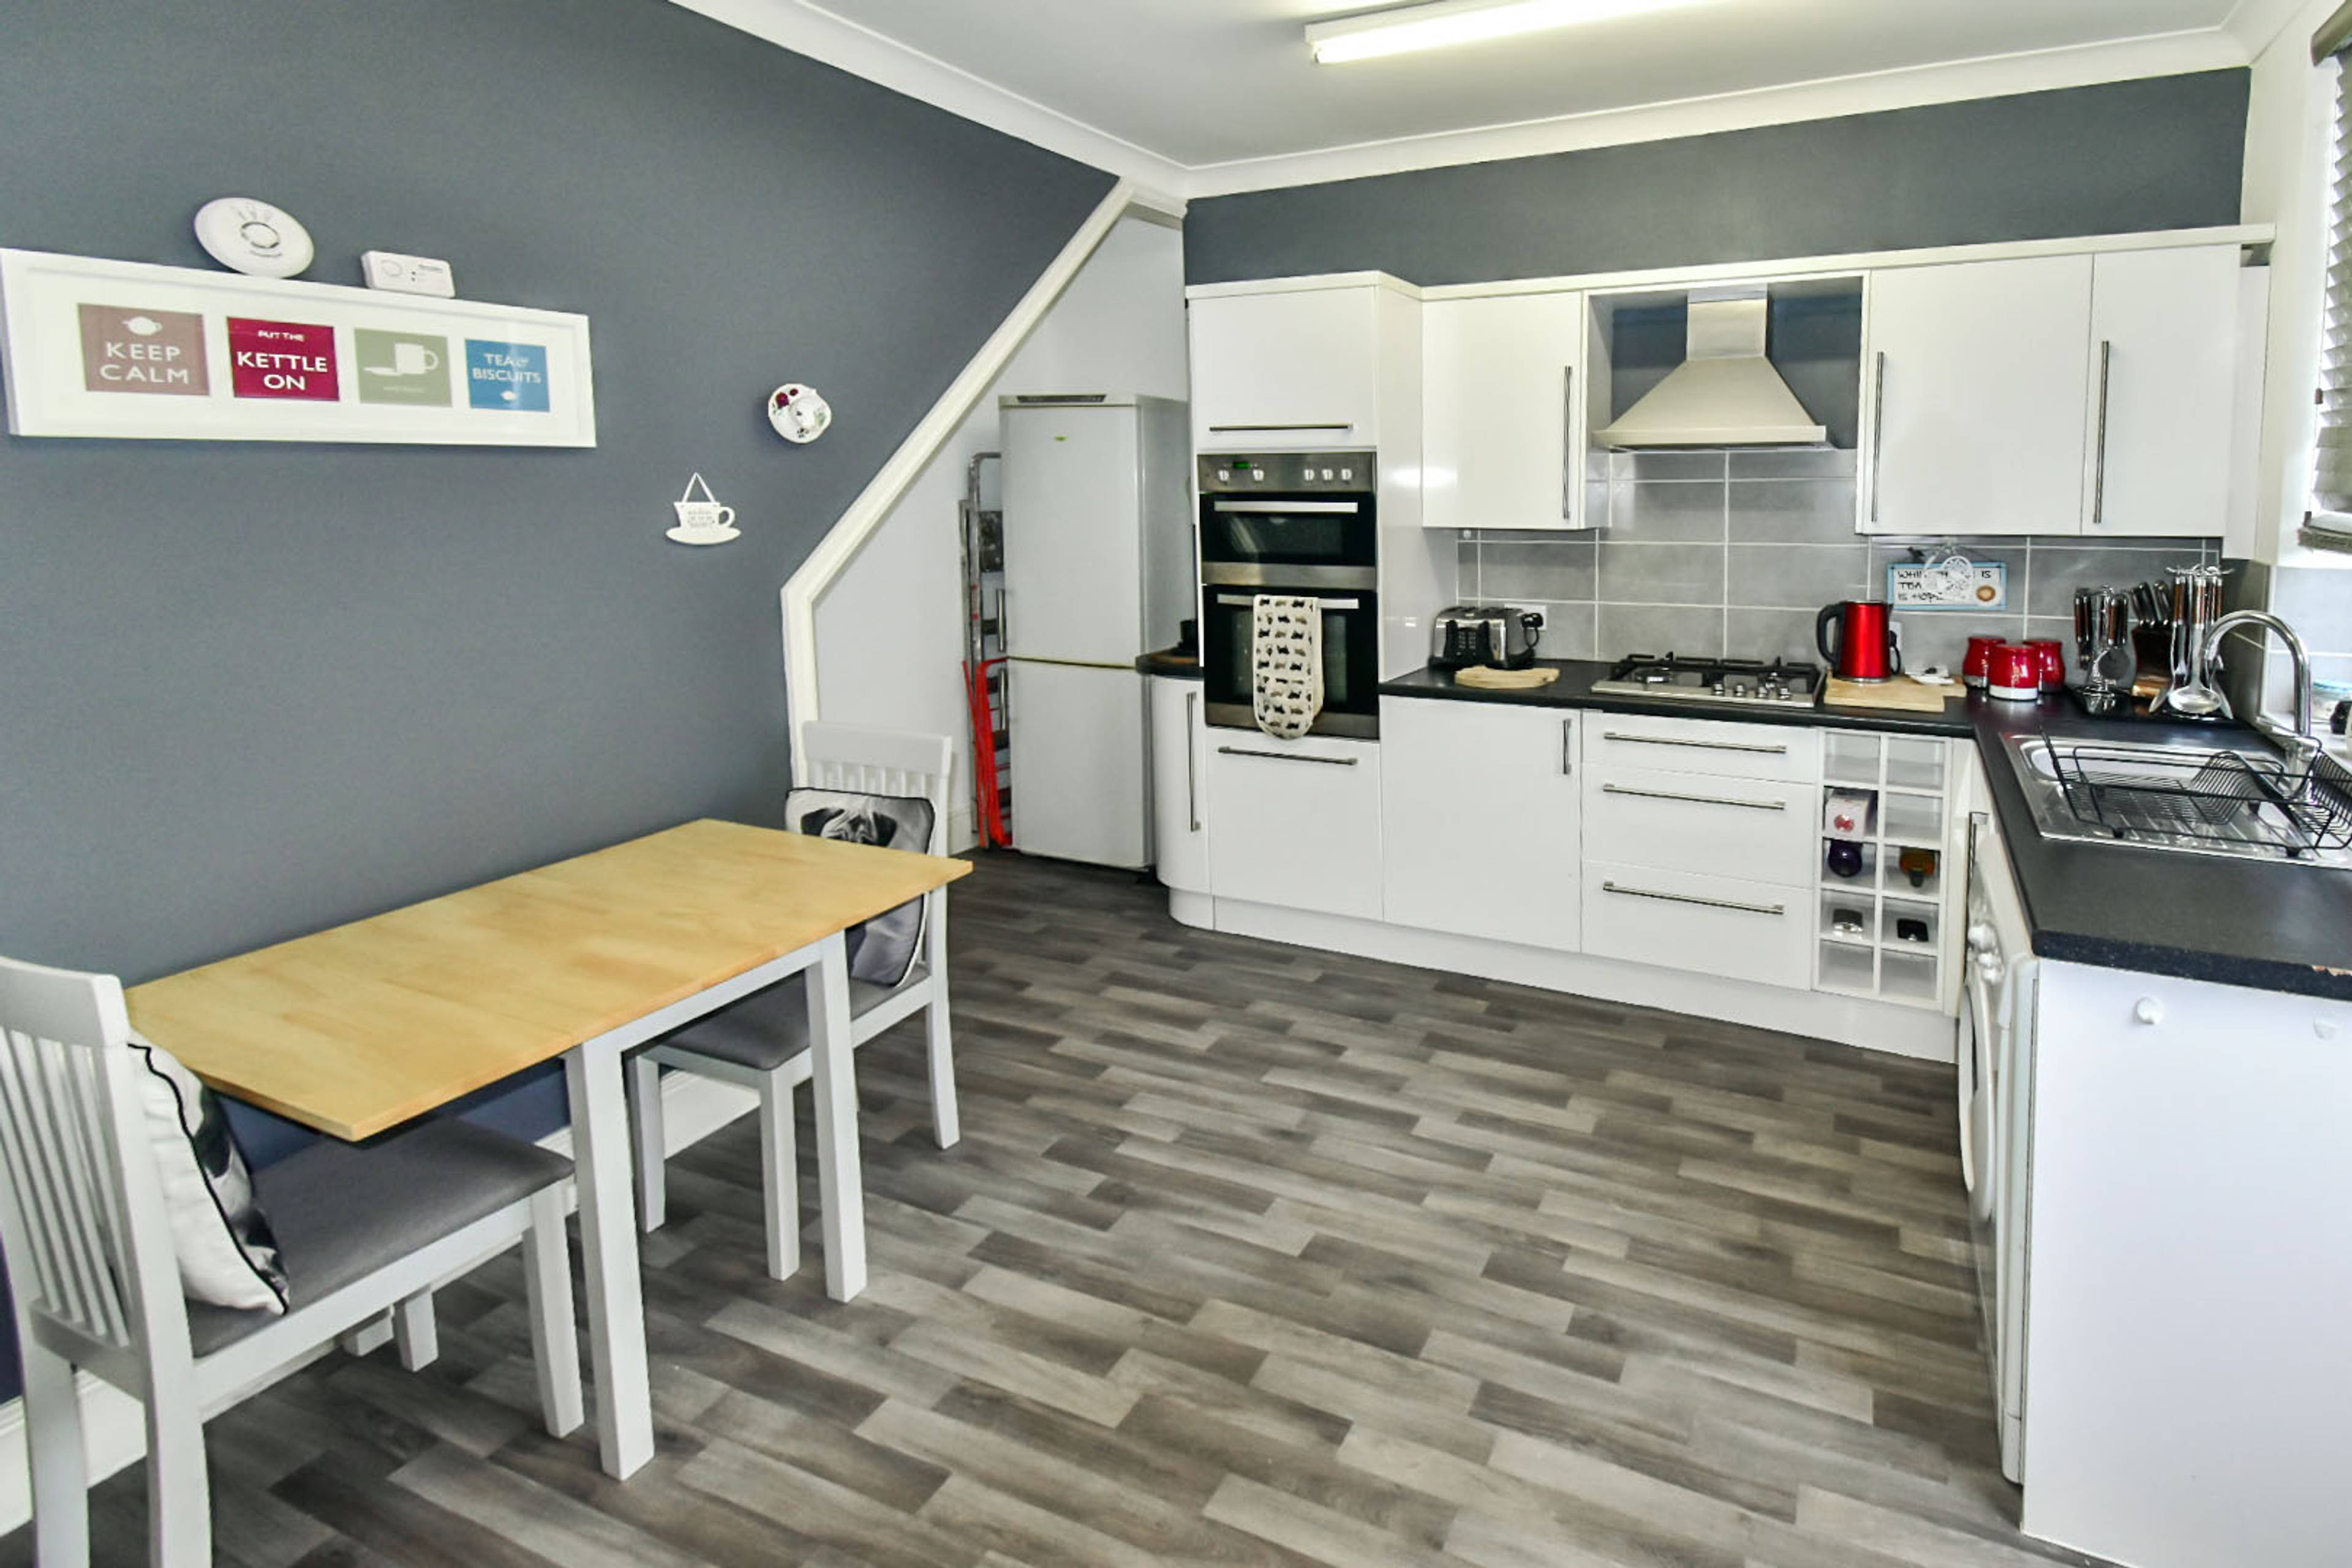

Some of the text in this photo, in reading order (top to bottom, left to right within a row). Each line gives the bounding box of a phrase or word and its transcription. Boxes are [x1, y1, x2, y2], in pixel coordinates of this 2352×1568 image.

[282, 332, 306, 342] THE
[106, 342, 181, 361] KEEP
[236, 351, 328, 372] KETTLE
[484, 353, 514, 367] TEA
[100, 364, 189, 384] CALM
[263, 374, 306, 390] ON
[472, 368, 542, 384] BISCUITS
[1981, 570, 1992, 579] IS
